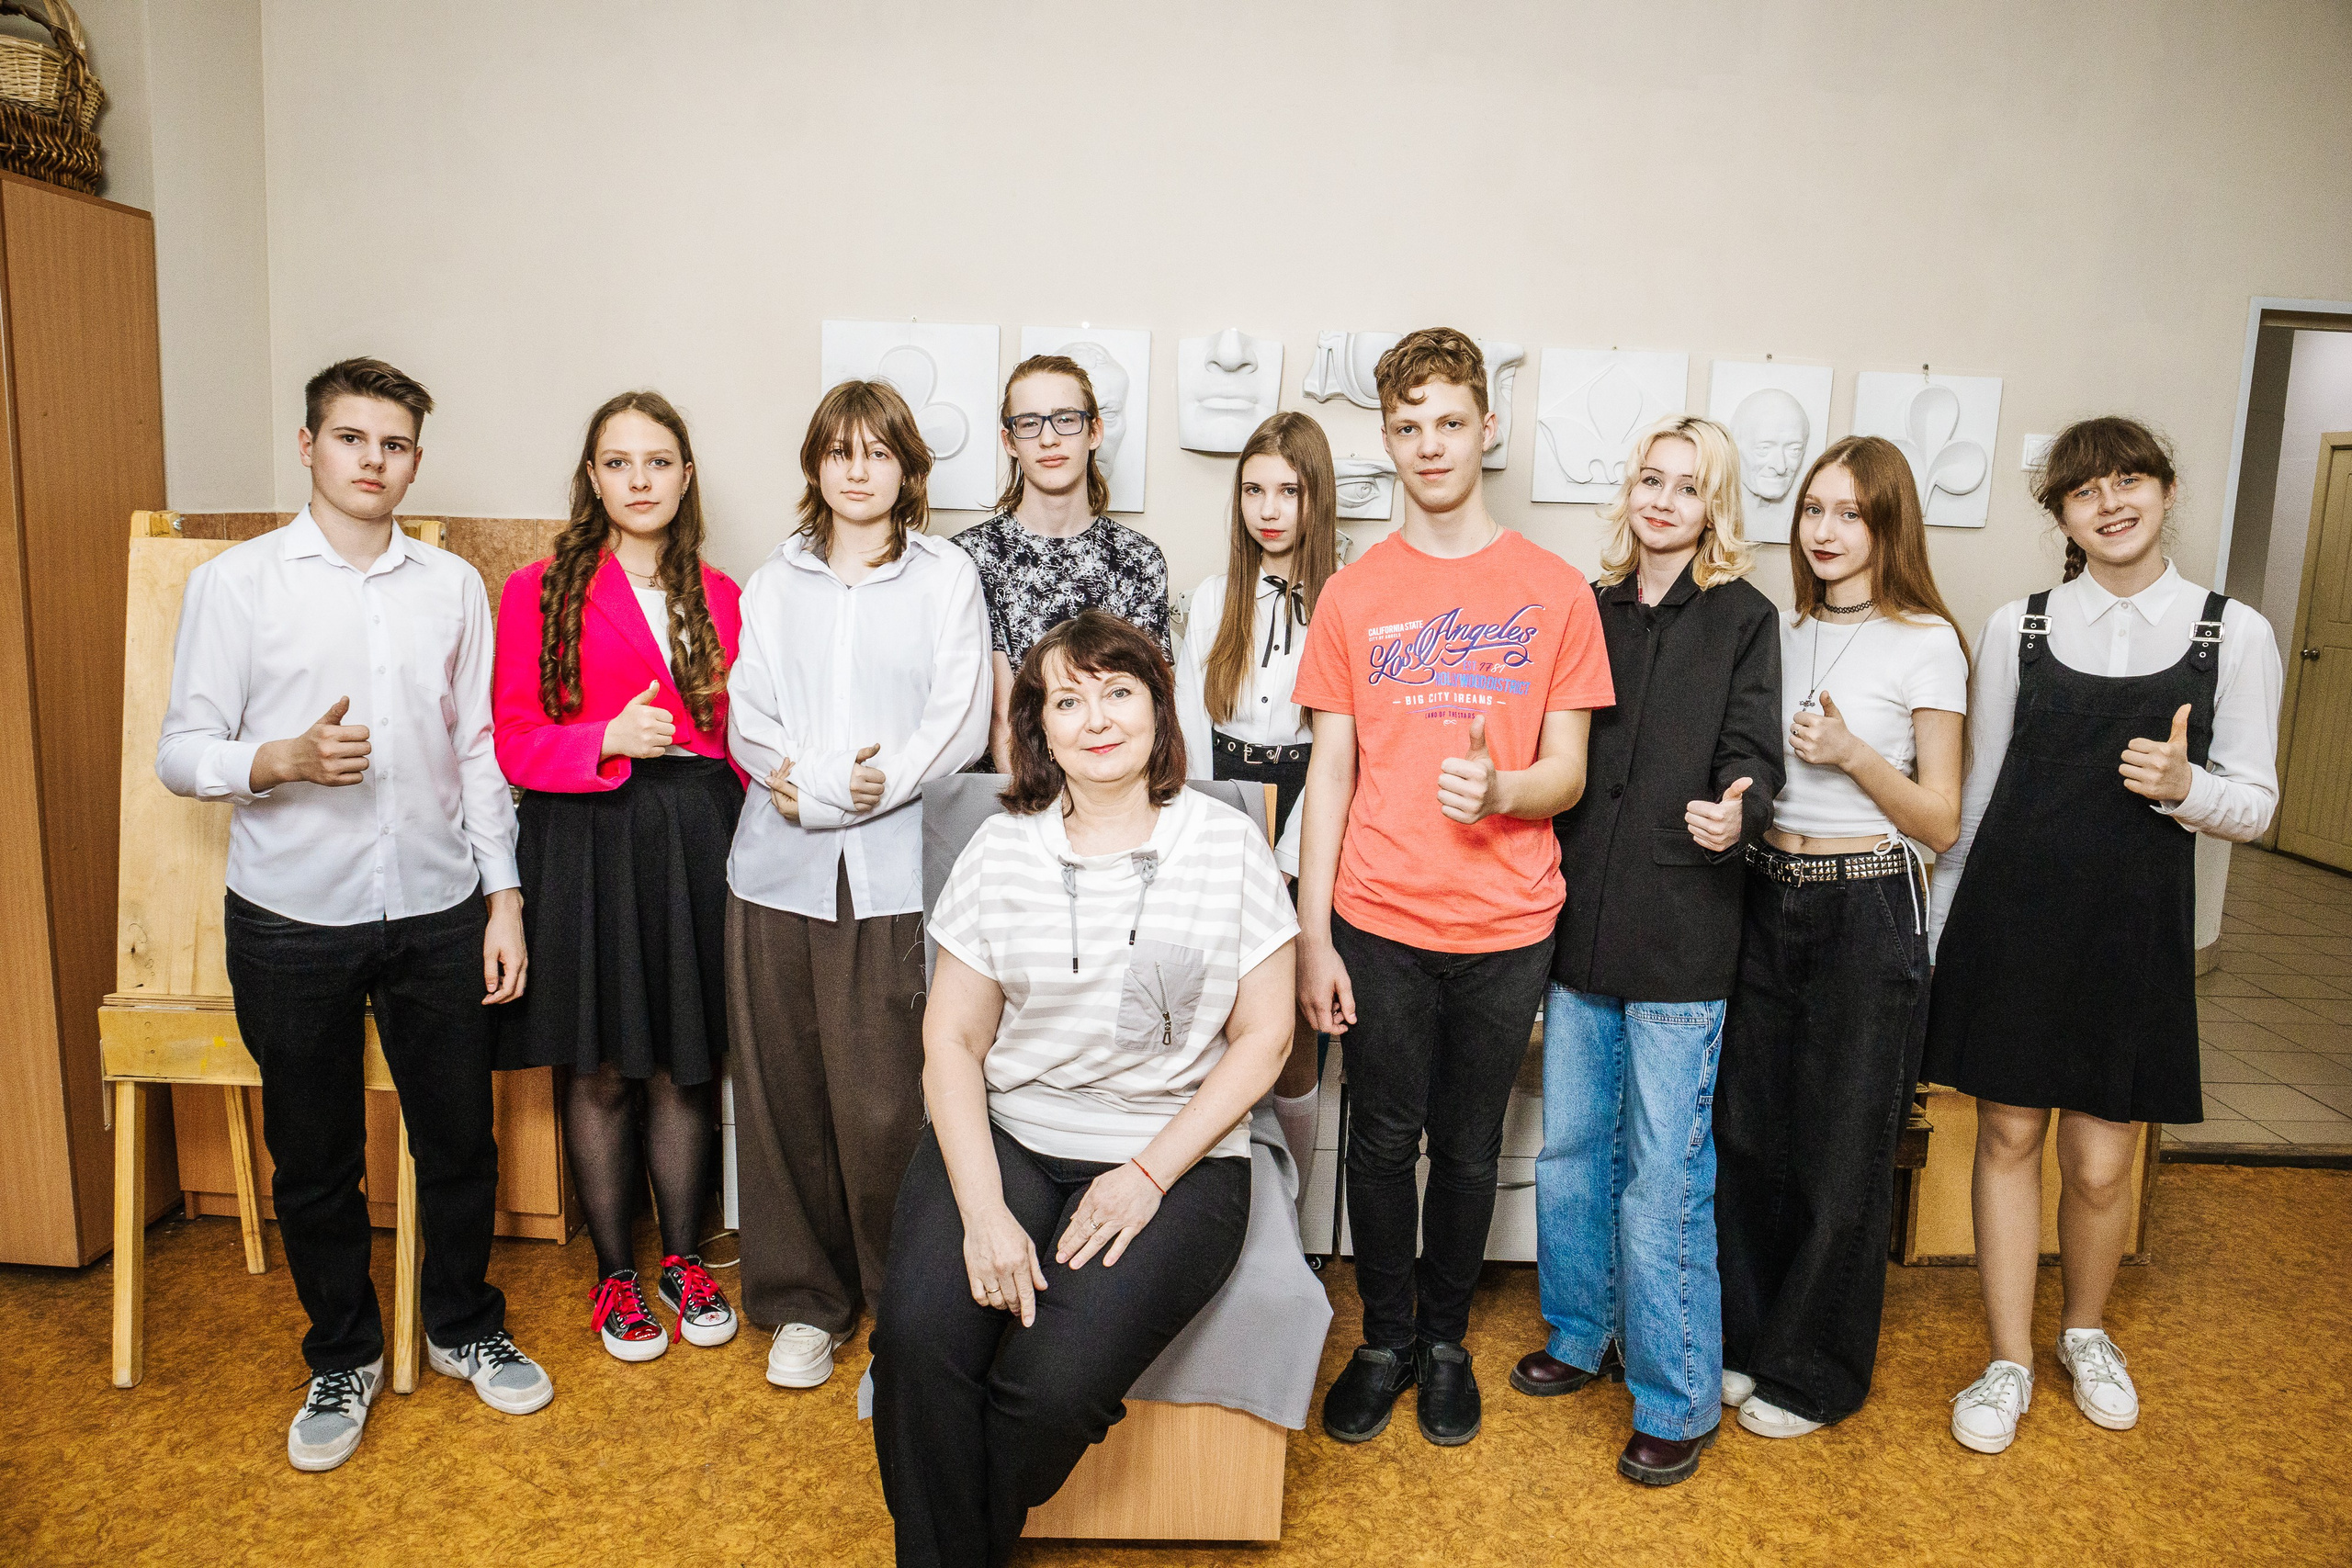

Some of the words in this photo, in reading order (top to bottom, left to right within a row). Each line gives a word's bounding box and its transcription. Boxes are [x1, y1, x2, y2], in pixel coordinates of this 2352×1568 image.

[1368, 624, 1404, 637] CALIFORNIA
[1405, 620, 1423, 631] STATE
[1368, 638, 1435, 685] Los
[1412, 604, 1545, 668] Angeles
[1463, 660, 1478, 671] EST.
[1405, 694, 1424, 705] BIG
[1429, 692, 1450, 703] CITY
